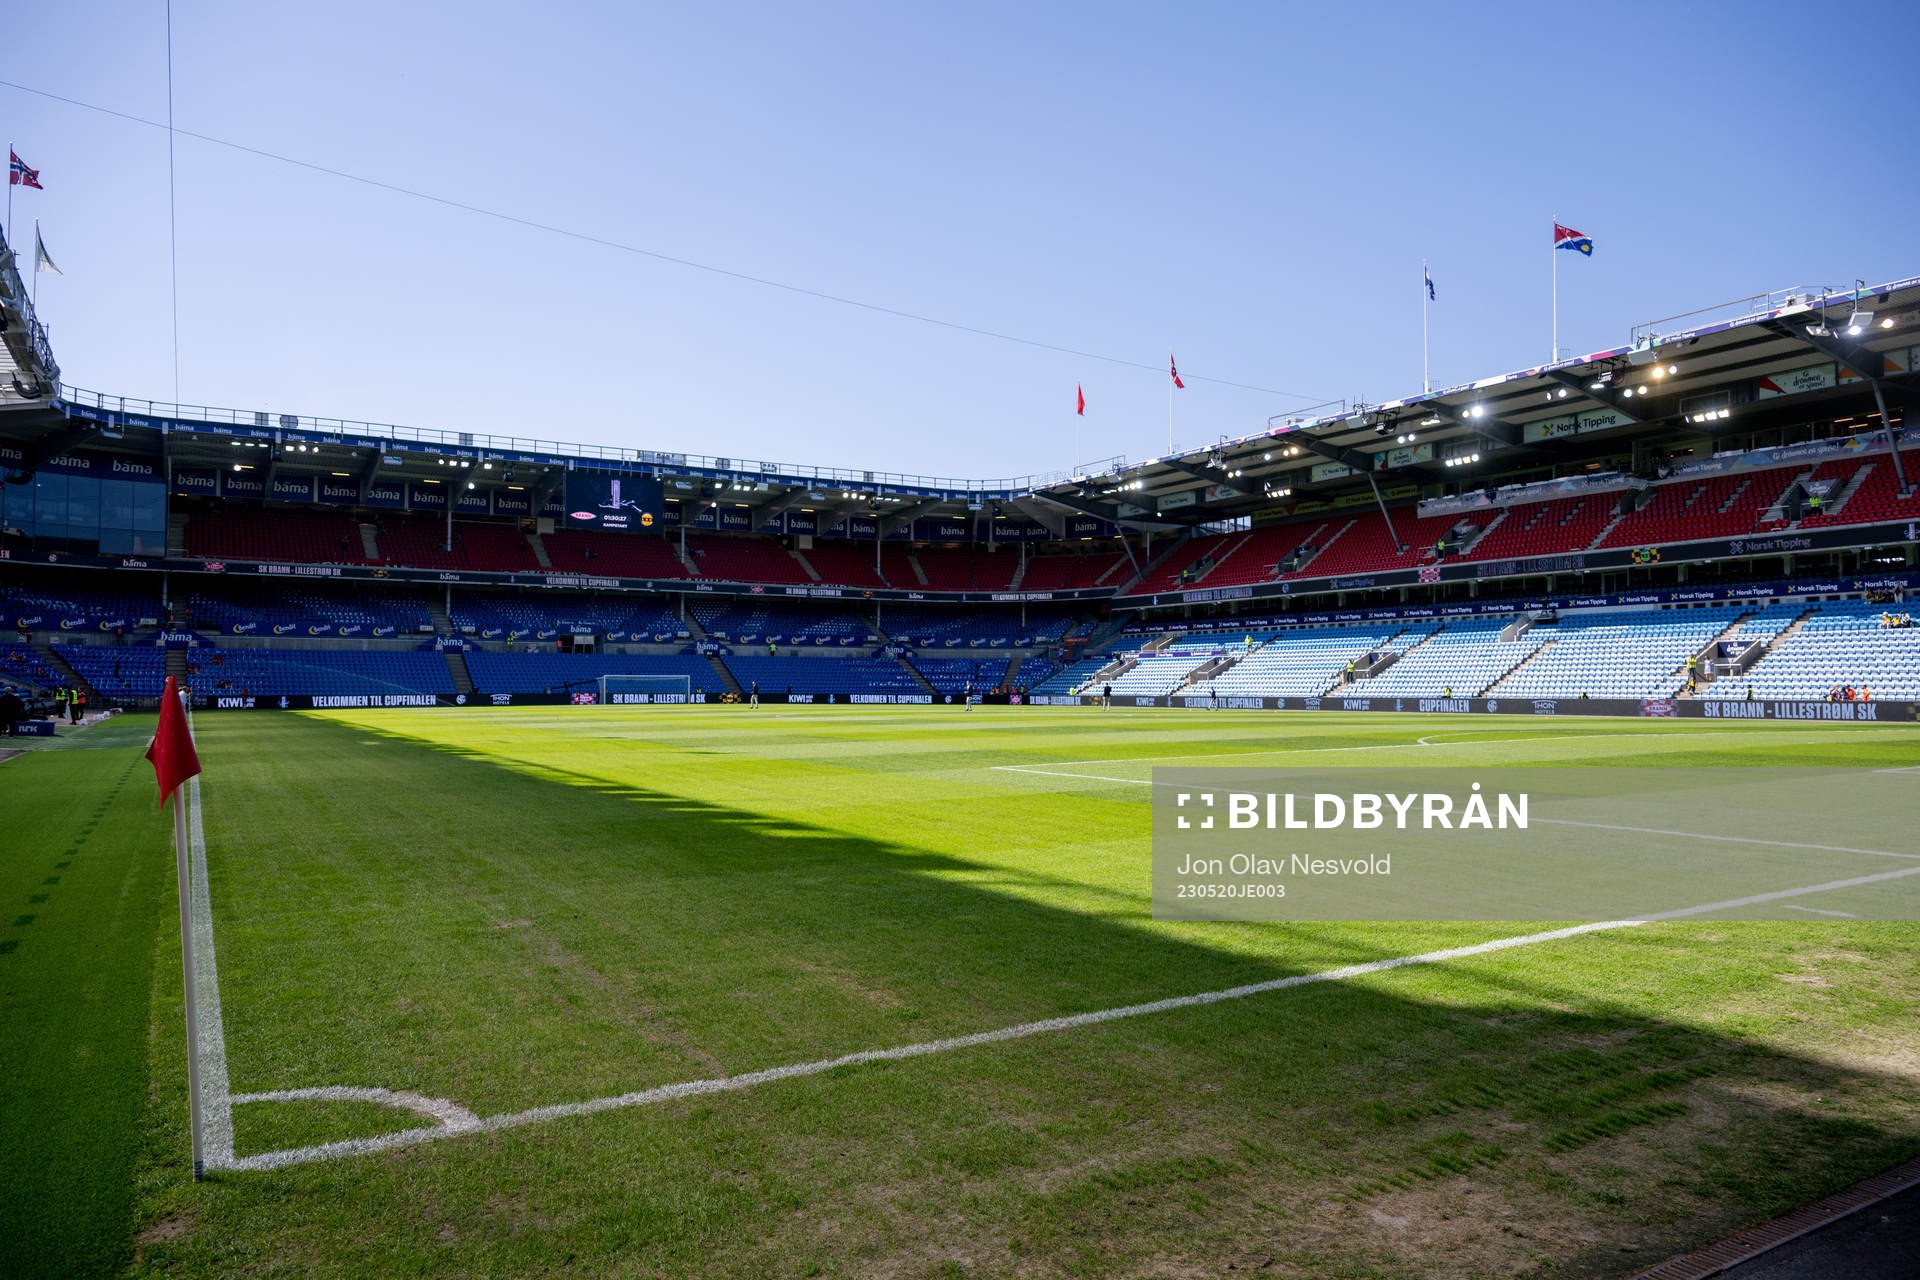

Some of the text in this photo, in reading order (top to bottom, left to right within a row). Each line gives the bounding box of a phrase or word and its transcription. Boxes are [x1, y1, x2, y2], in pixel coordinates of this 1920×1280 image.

[1557, 415, 1616, 432] Nork Tipping
[112, 460, 153, 474] bama
[177, 474, 215, 487] bama
[227, 478, 263, 491] bama
[273, 481, 309, 494] bama
[324, 485, 357, 498] bama
[413, 491, 445, 503] bama
[498, 498, 528, 510] bama
[723, 513, 748, 525] bama
[1746, 537, 1811, 551] Norsk Tipping
[122, 559, 147, 568] bama
[161, 631, 192, 642] bama
[437, 636, 463, 647] bama
[696, 642, 719, 650] bama
[218, 697, 243, 708] KIWI
[312, 695, 436, 707] VELKOMMEN TIL CUPFINALEN
[613, 694, 623, 703] SK
[624, 694, 649, 703] BRANN
[696, 694, 705, 703] SK
[788, 695, 805, 703] KIWI
[850, 694, 932, 704] VELKOMMEN TIL CUPFINALEN
[1343, 700, 1360, 710] KIWI
[1419, 700, 1470, 712] CUPFINALEN
[1703, 702, 1720, 717] SK
[1722, 702, 1765, 718] BRANN
[1775, 702, 1854, 719] LILLESTRØM
[1857, 703, 1877, 720] SK
